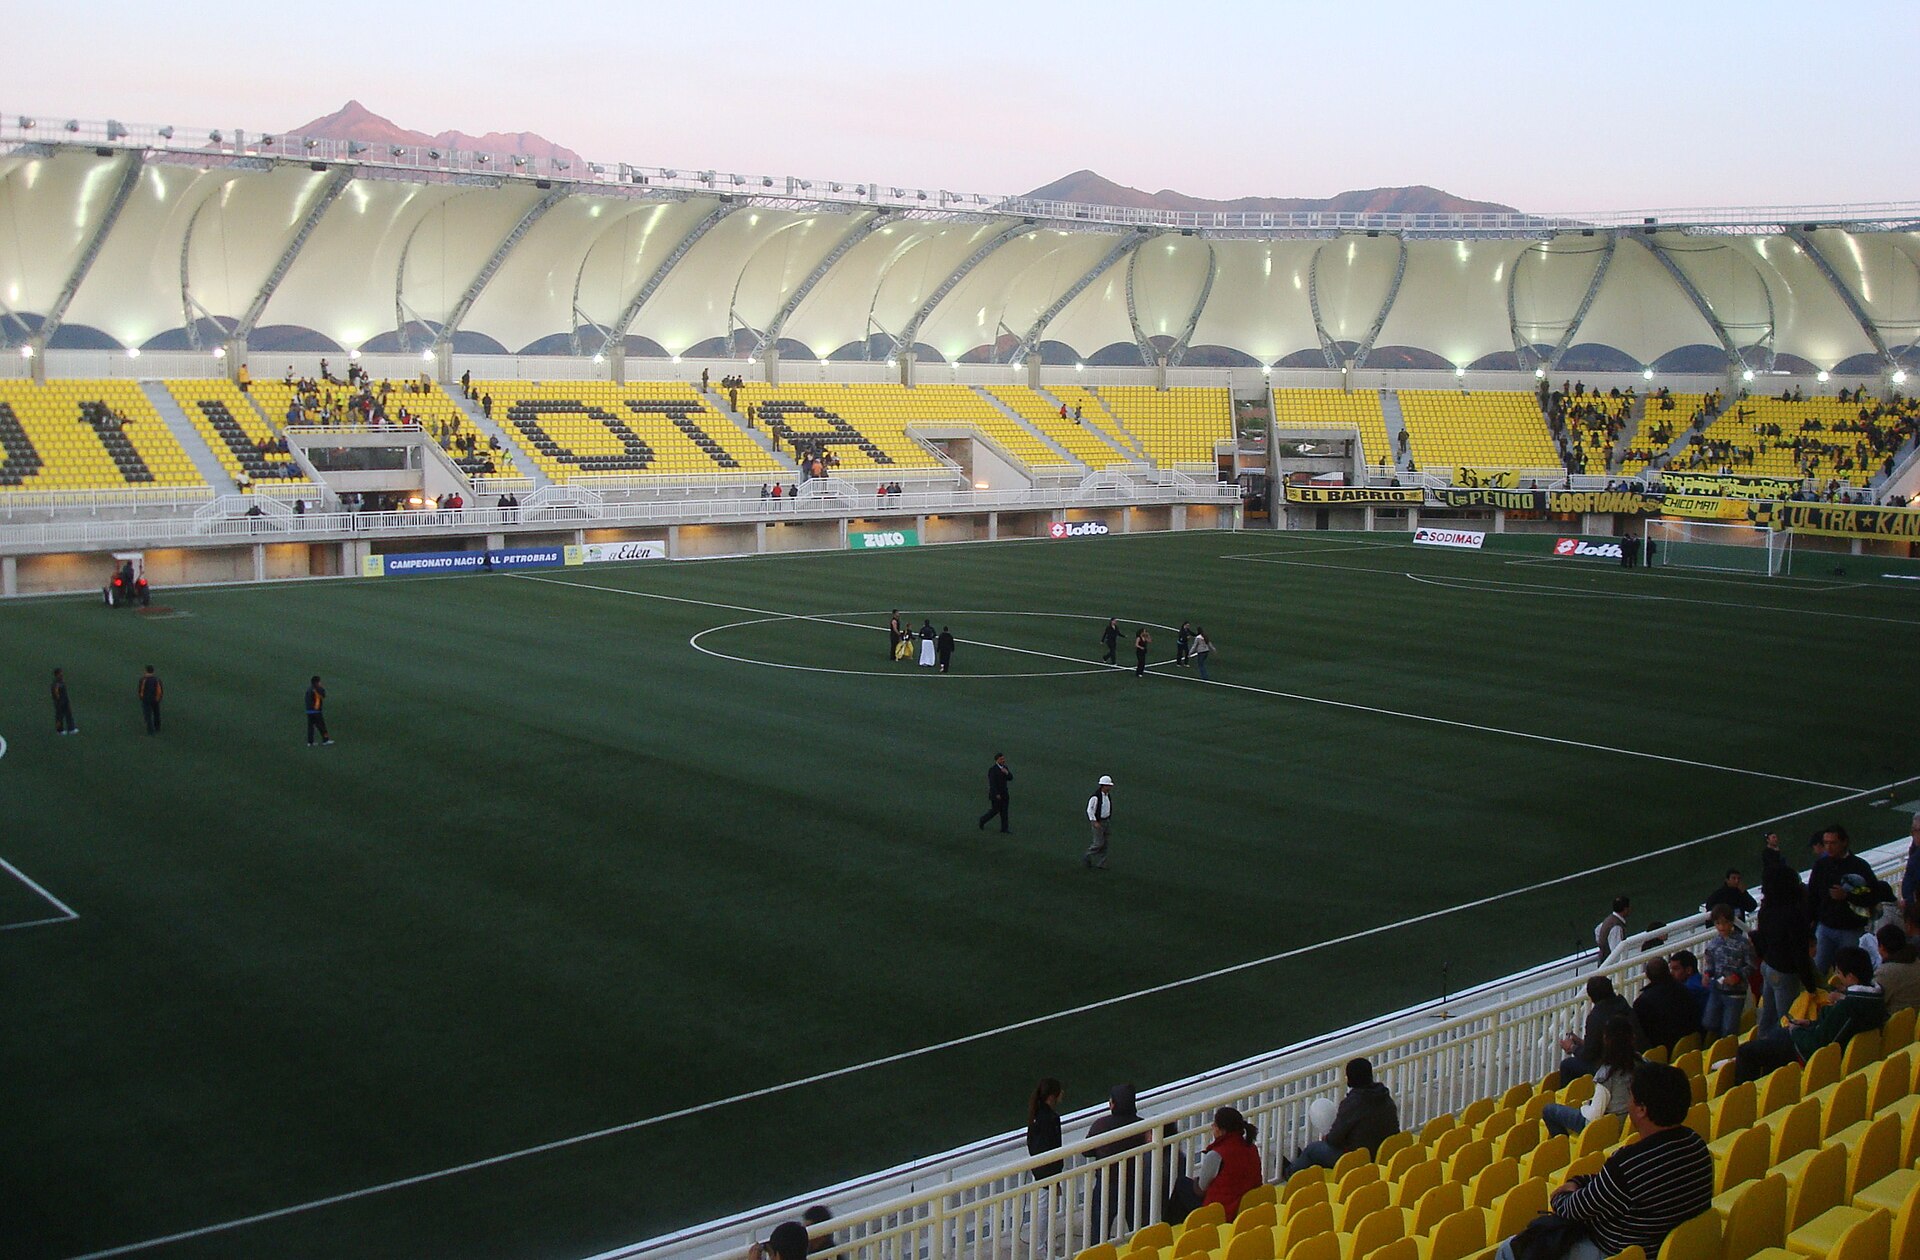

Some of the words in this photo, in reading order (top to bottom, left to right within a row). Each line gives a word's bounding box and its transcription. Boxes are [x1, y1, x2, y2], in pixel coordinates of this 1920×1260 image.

[1301, 489, 1322, 501] EL
[1327, 489, 1406, 502] BARRIO
[1434, 489, 1461, 506] EL
[1663, 497, 1694, 509] CHICO
[1695, 499, 1718, 511] MATI
[1790, 507, 1858, 532] ULTRA
[1065, 522, 1109, 537] lotto
[864, 531, 905, 548] ZUKO
[1428, 531, 1482, 546] SODIMAC
[390, 557, 452, 569] CAMPEONATO
[454, 555, 501, 566] NACIOAL
[503, 552, 557, 564] PETROBRAS
